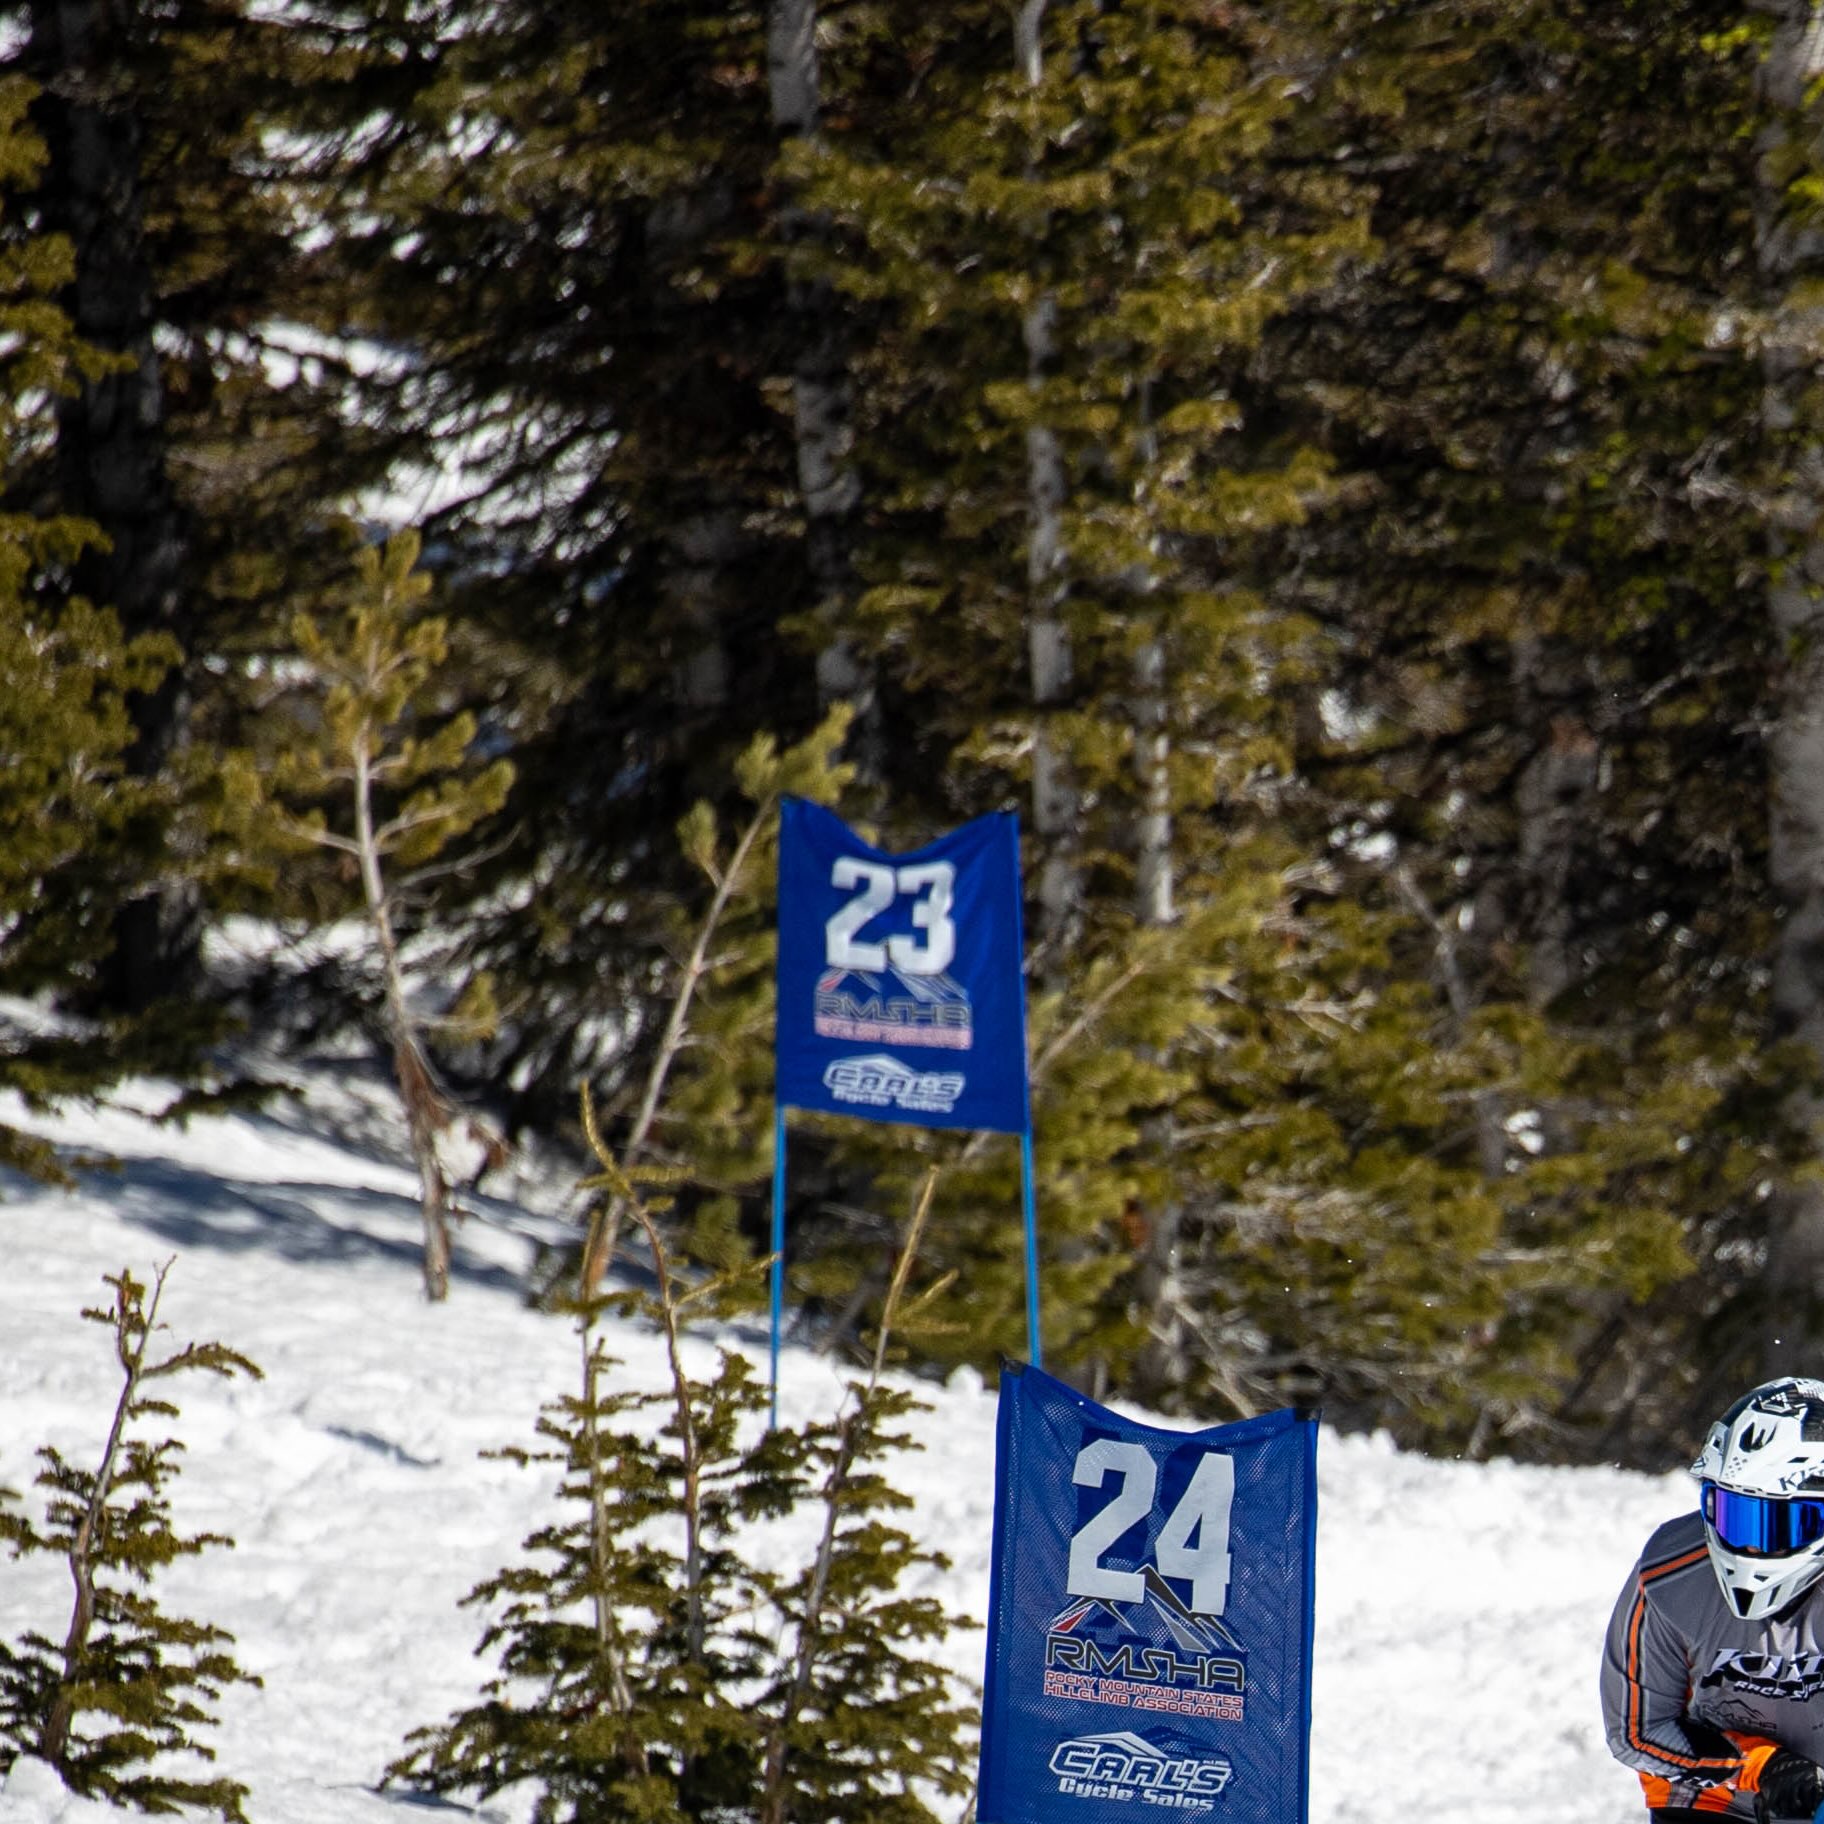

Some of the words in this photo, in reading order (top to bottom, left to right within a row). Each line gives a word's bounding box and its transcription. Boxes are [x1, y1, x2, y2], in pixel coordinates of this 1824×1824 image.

[826, 856, 956, 976] 23
[1066, 1438, 1235, 1616] 24
[1046, 1635, 1245, 1692] RMSHA
[1044, 1682, 1130, 1706] HILLCLIMB
[1132, 1697, 1243, 1722] ASSOCIATION
[1045, 1671, 1095, 1687] ROCKY
[1099, 1678, 1180, 1699] MOUNTAIN
[1183, 1690, 1244, 1708] STATES
[1733, 1680, 1788, 1698] RACE
[1058, 1777, 1134, 1802] Cycle
[1143, 1789, 1214, 1811] Sales
